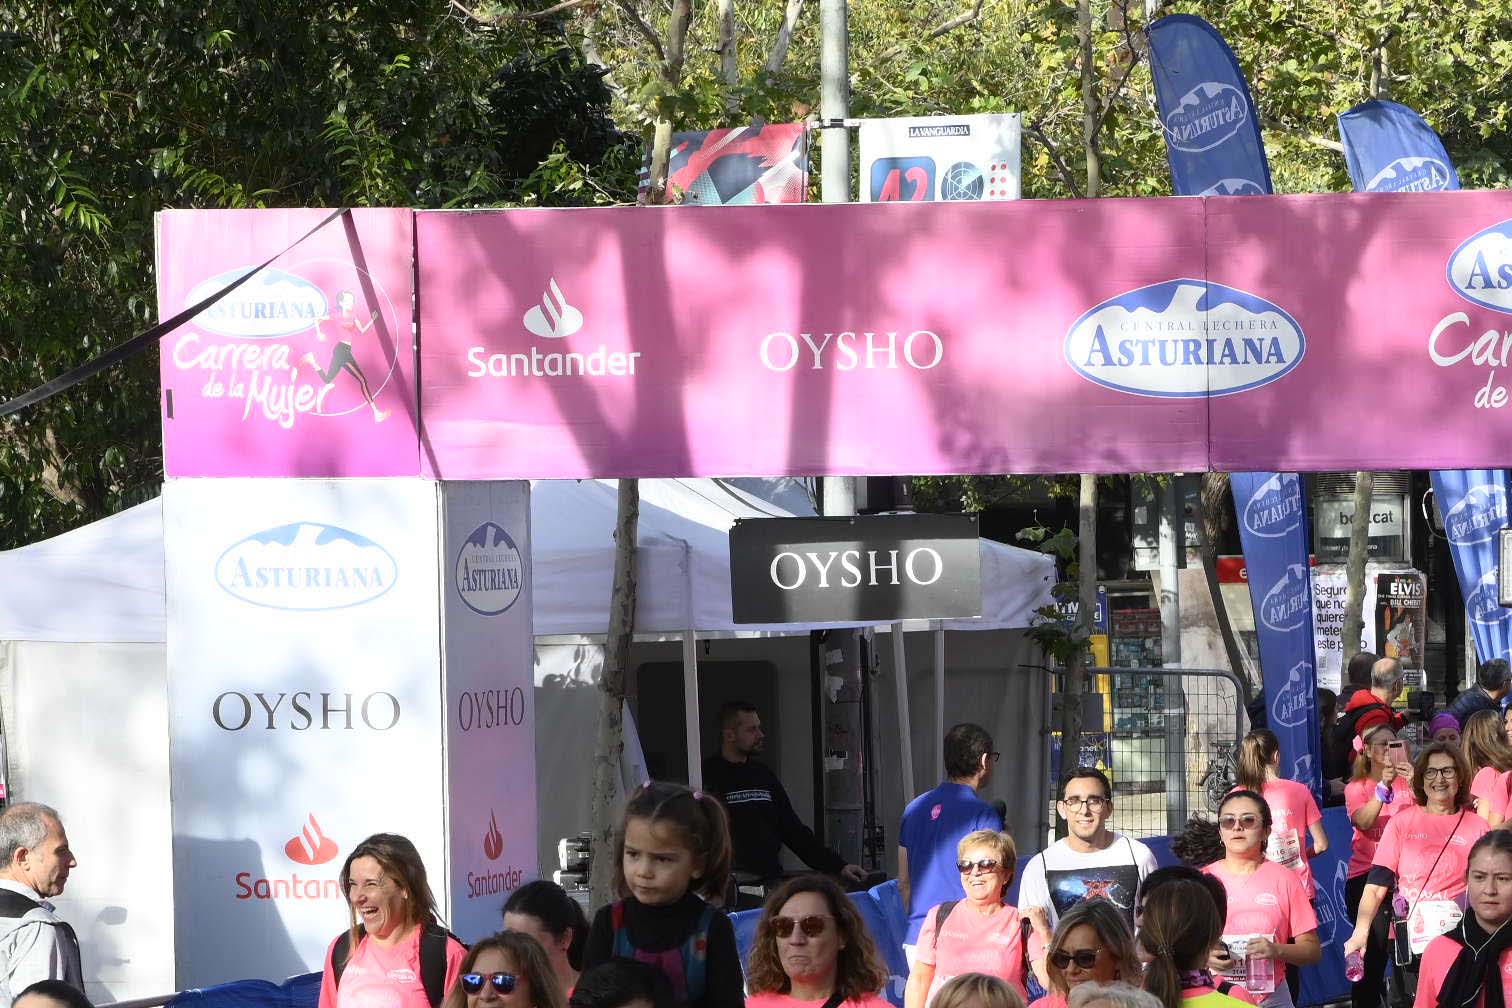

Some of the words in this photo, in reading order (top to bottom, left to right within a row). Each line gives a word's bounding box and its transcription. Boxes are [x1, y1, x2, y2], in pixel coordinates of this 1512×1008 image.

[1120, 320, 1195, 331] CENTRAL
[1202, 319, 1278, 331] LECHERA
[173, 332, 290, 369] Carrera
[467, 346, 641, 378] Santander
[760, 331, 944, 371] OYSHO
[1083, 324, 1286, 367] ASTURIANA
[202, 371, 223, 398] de
[229, 371, 246, 398] la
[242, 368, 335, 428] Mujer
[1473, 370, 1508, 409] de
[231, 556, 385, 588] ASTURIANA
[461, 558, 519, 593] ASTURIANA
[770, 548, 944, 590] OYSHO
[1315, 600, 1332, 613] que
[1390, 583, 1421, 595] ELVIS
[1317, 637, 1336, 649] este
[211, 691, 400, 731] OYSHO
[458, 687, 525, 731] OYSHO
[235, 872, 342, 900] Santan
[467, 869, 522, 898] Santander
